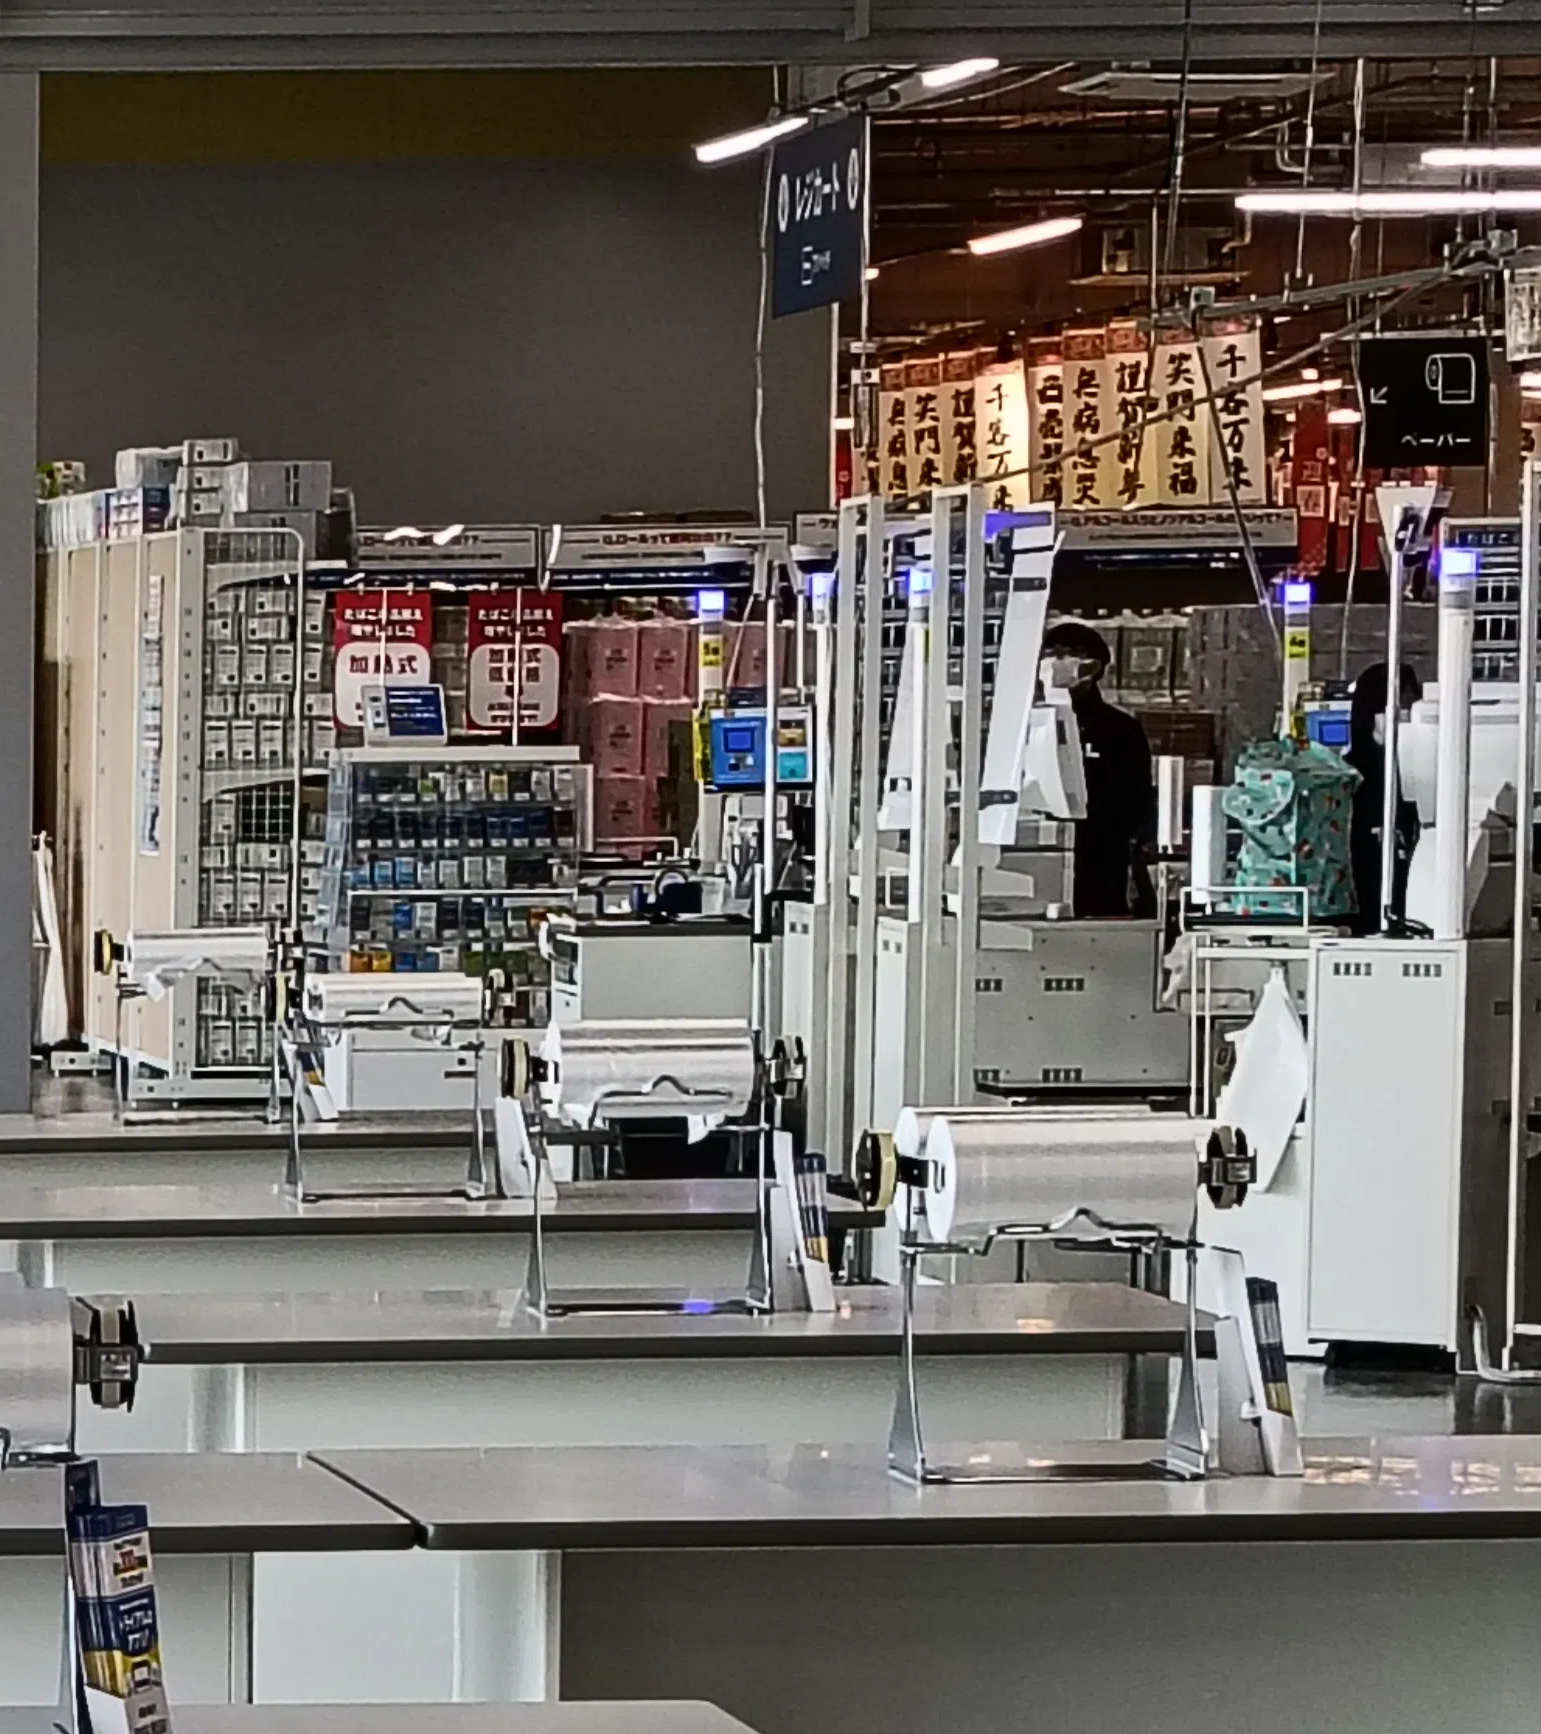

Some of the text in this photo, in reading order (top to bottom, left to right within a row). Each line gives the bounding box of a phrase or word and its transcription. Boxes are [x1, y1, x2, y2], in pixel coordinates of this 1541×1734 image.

[1165, 352, 1198, 496] 笑門来福
[1216, 344, 1253, 491] 千客万来
[1401, 434, 1471, 447] ペーパー
[344, 608, 423, 621] たばこ品揃え
[477, 608, 554, 620] たばこ品揃え
[484, 625, 547, 638] 増やしした
